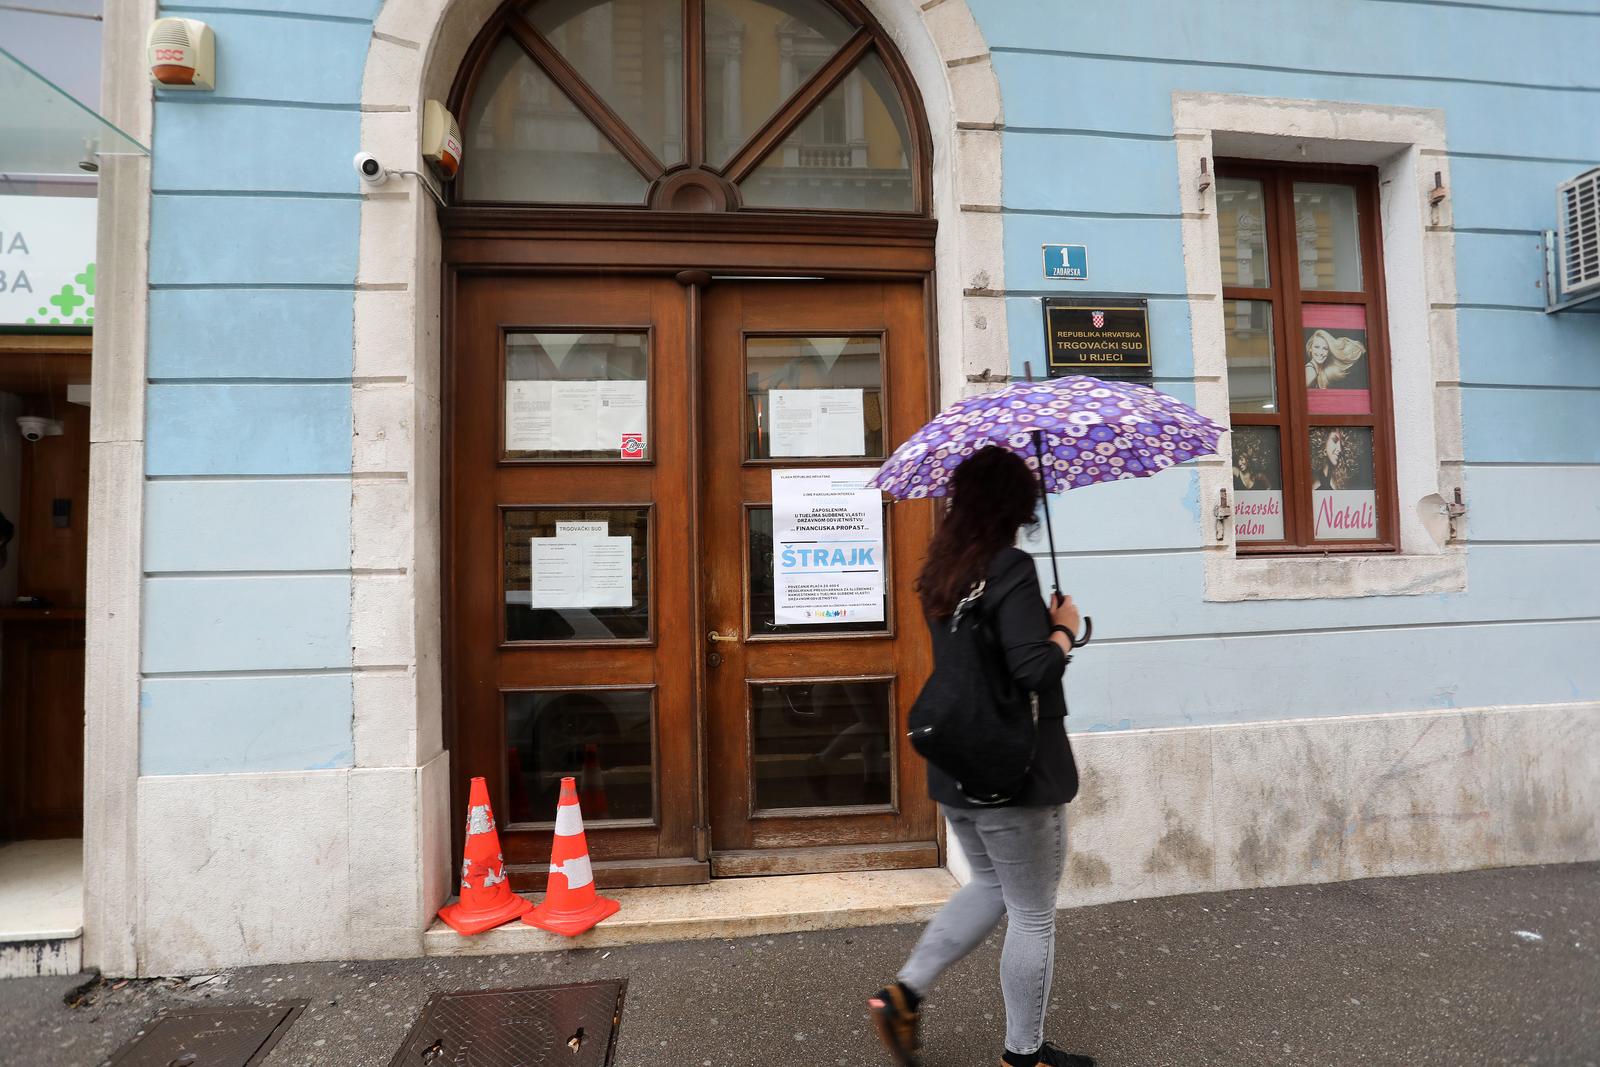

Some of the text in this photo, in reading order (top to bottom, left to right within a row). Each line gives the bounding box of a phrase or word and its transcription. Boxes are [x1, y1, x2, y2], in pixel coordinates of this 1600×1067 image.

[155, 49, 184, 62] DSC
[1060, 247, 1070, 267] 1
[1053, 267, 1081, 276] ZADARSKA
[1056, 340, 1143, 350] TRGOVAČKI SUD
[1079, 353, 1123, 361] U RIJECI
[1234, 497, 1280, 515] rizerski
[1315, 495, 1373, 537] Natali
[1234, 520, 1265, 536] salon
[781, 544, 875, 568] ŠTRAJK
